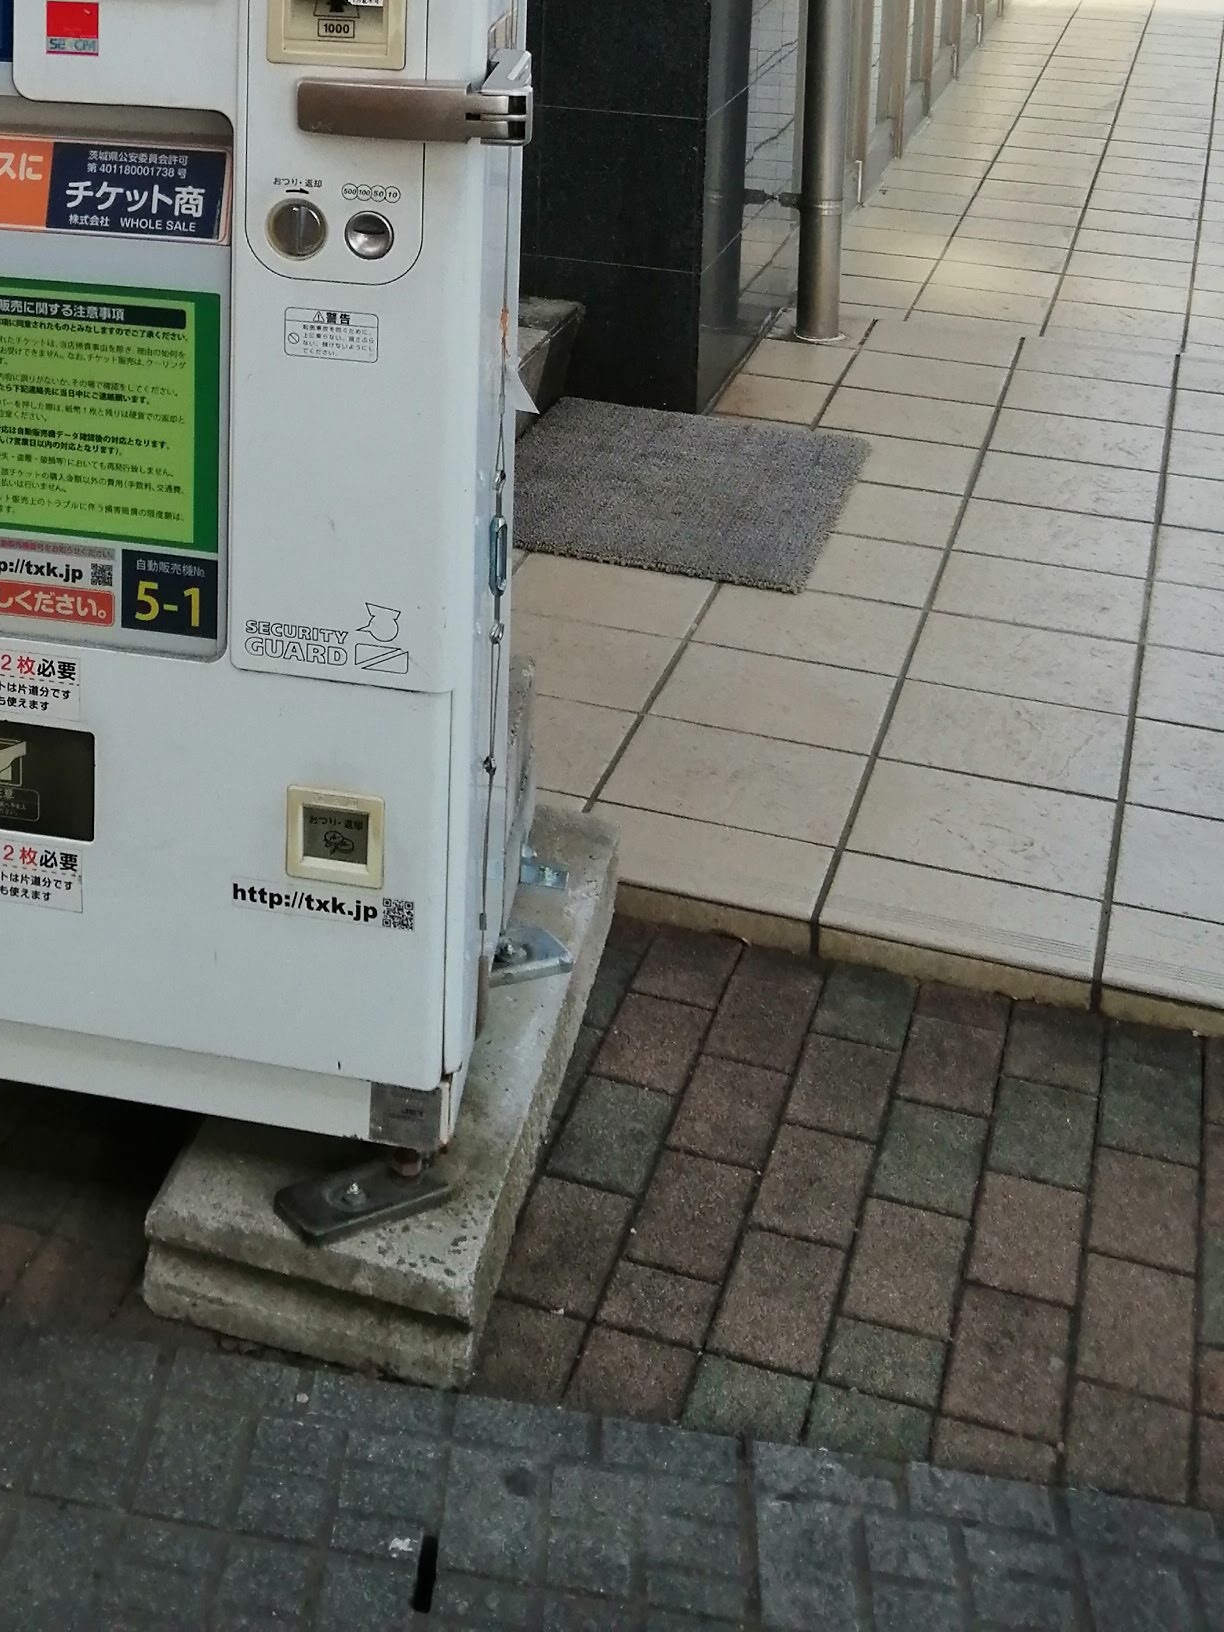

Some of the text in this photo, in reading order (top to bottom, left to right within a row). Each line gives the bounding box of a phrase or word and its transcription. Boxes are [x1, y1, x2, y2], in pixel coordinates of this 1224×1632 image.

[322, 23, 351, 34] 1000
[98, 163, 176, 179] 401180001738
[65, 180, 205, 219] チケット商
[343, 188, 357, 196] 500
[358, 189, 371, 197] 100
[68, 213, 197, 233] 株式会社 WHOLE SALE
[326, 312, 351, 326] 警告
[135, 580, 201, 628] 5-1
[245, 620, 349, 645] SECURITY
[245, 636, 349, 666] GUARD
[232, 882, 379, 922] http://txk.jp
